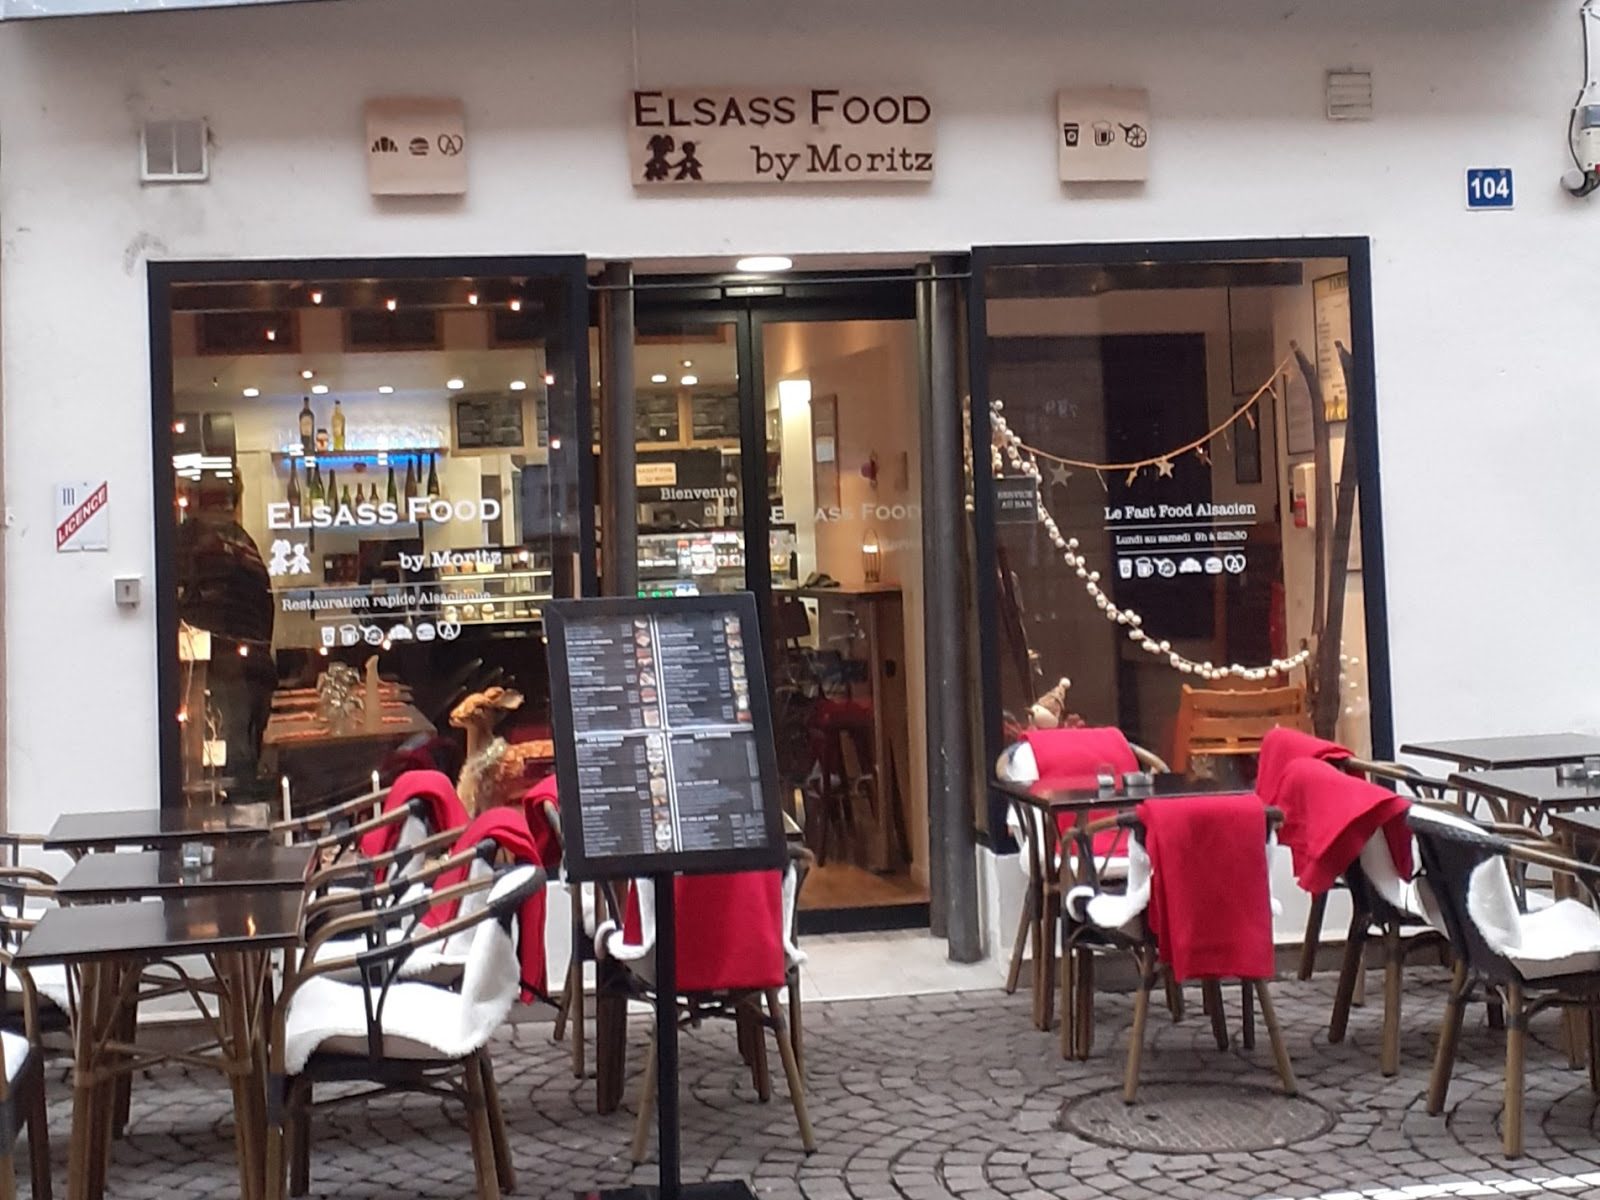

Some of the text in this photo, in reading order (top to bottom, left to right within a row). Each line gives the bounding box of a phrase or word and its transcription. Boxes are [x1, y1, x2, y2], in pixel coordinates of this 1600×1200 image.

[633, 89, 931, 127] ELSASS FOOD
[750, 144, 934, 181] by Moritz
[1470, 176, 1510, 200] 104
[660, 487, 738, 501] Bienvenue
[58, 486, 106, 543] LICENCE
[266, 496, 500, 530] ELSASS FOOD
[1104, 502, 1257, 520] Le Fast Food Alsacien
[1115, 534, 1143, 545] Lundi
[1144, 535, 1157, 544] au
[1158, 532, 1191, 543] samedi
[398, 549, 503, 573] by Moritz
[282, 595, 369, 612] Restauration
[372, 591, 416, 609] rapide
